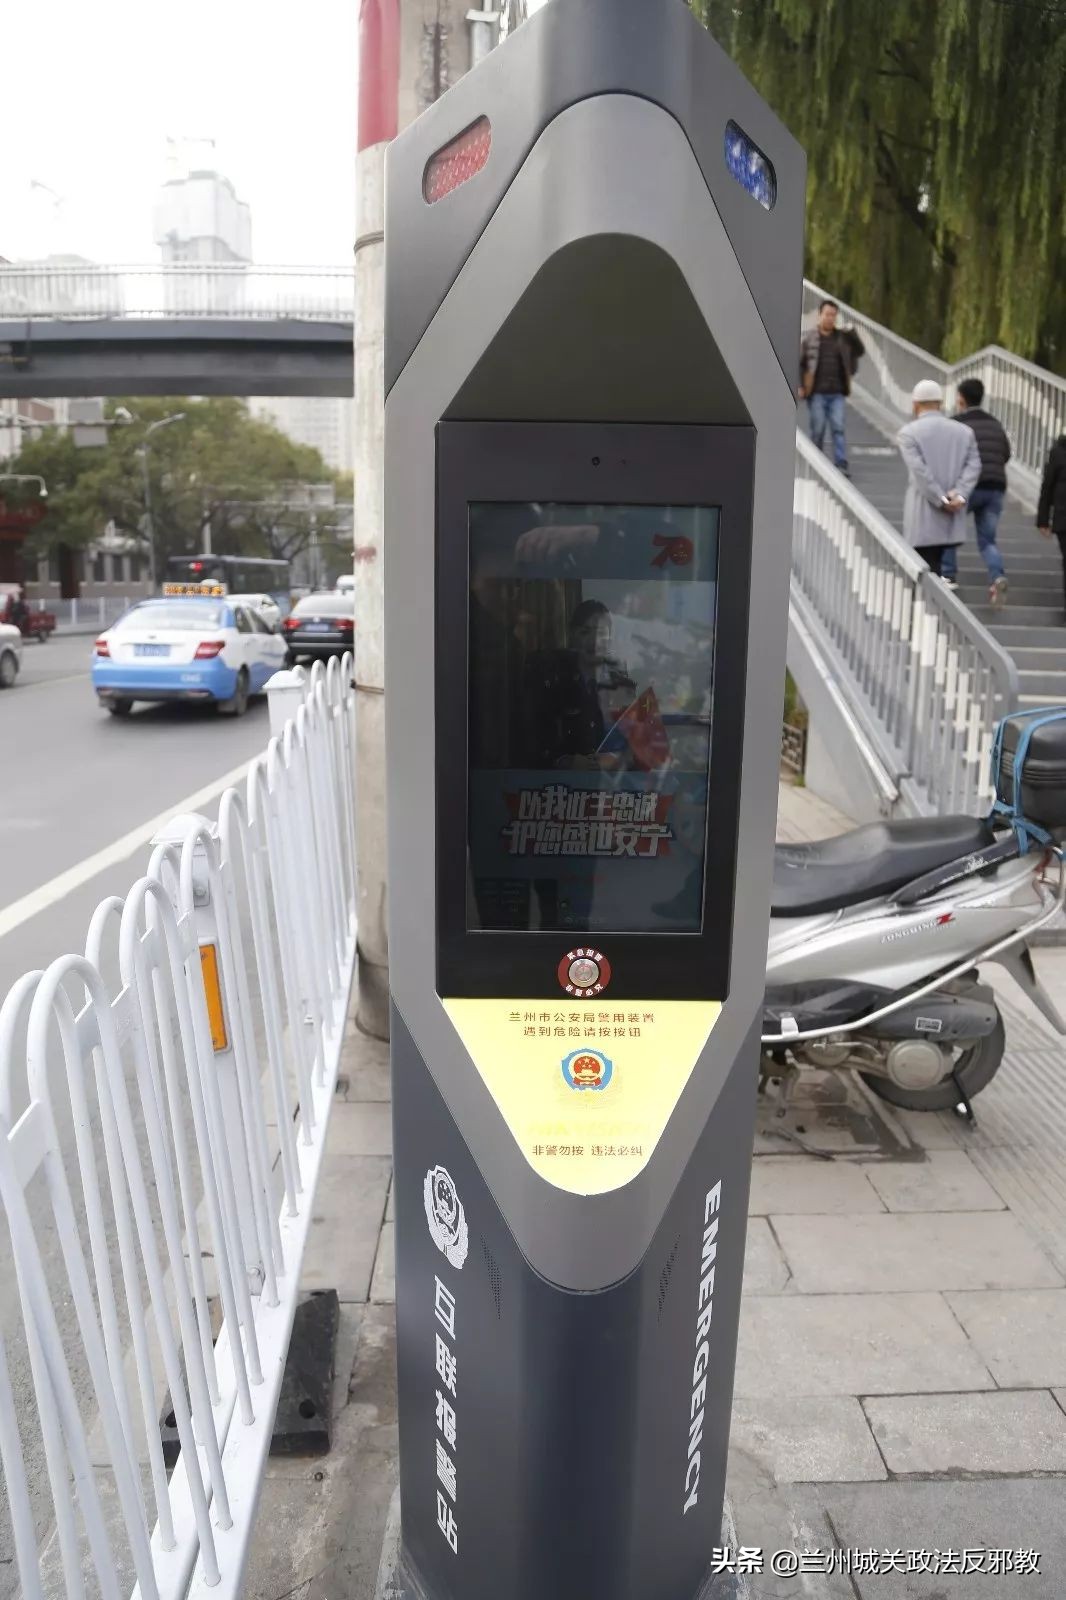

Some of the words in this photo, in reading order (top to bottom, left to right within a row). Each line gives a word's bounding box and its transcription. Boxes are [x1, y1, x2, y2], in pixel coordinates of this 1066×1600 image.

[501, 819, 674, 857] 护您盛世安宁
[509, 1011, 656, 1023] 兰州市公安局警用装置
[523, 1026, 642, 1038] 遇到危险请按按钮
[532, 1145, 584, 1157] 非警勿按
[684, 1179, 722, 1515] EMERGENCY
[434, 1274, 458, 1555] 互联报警站
